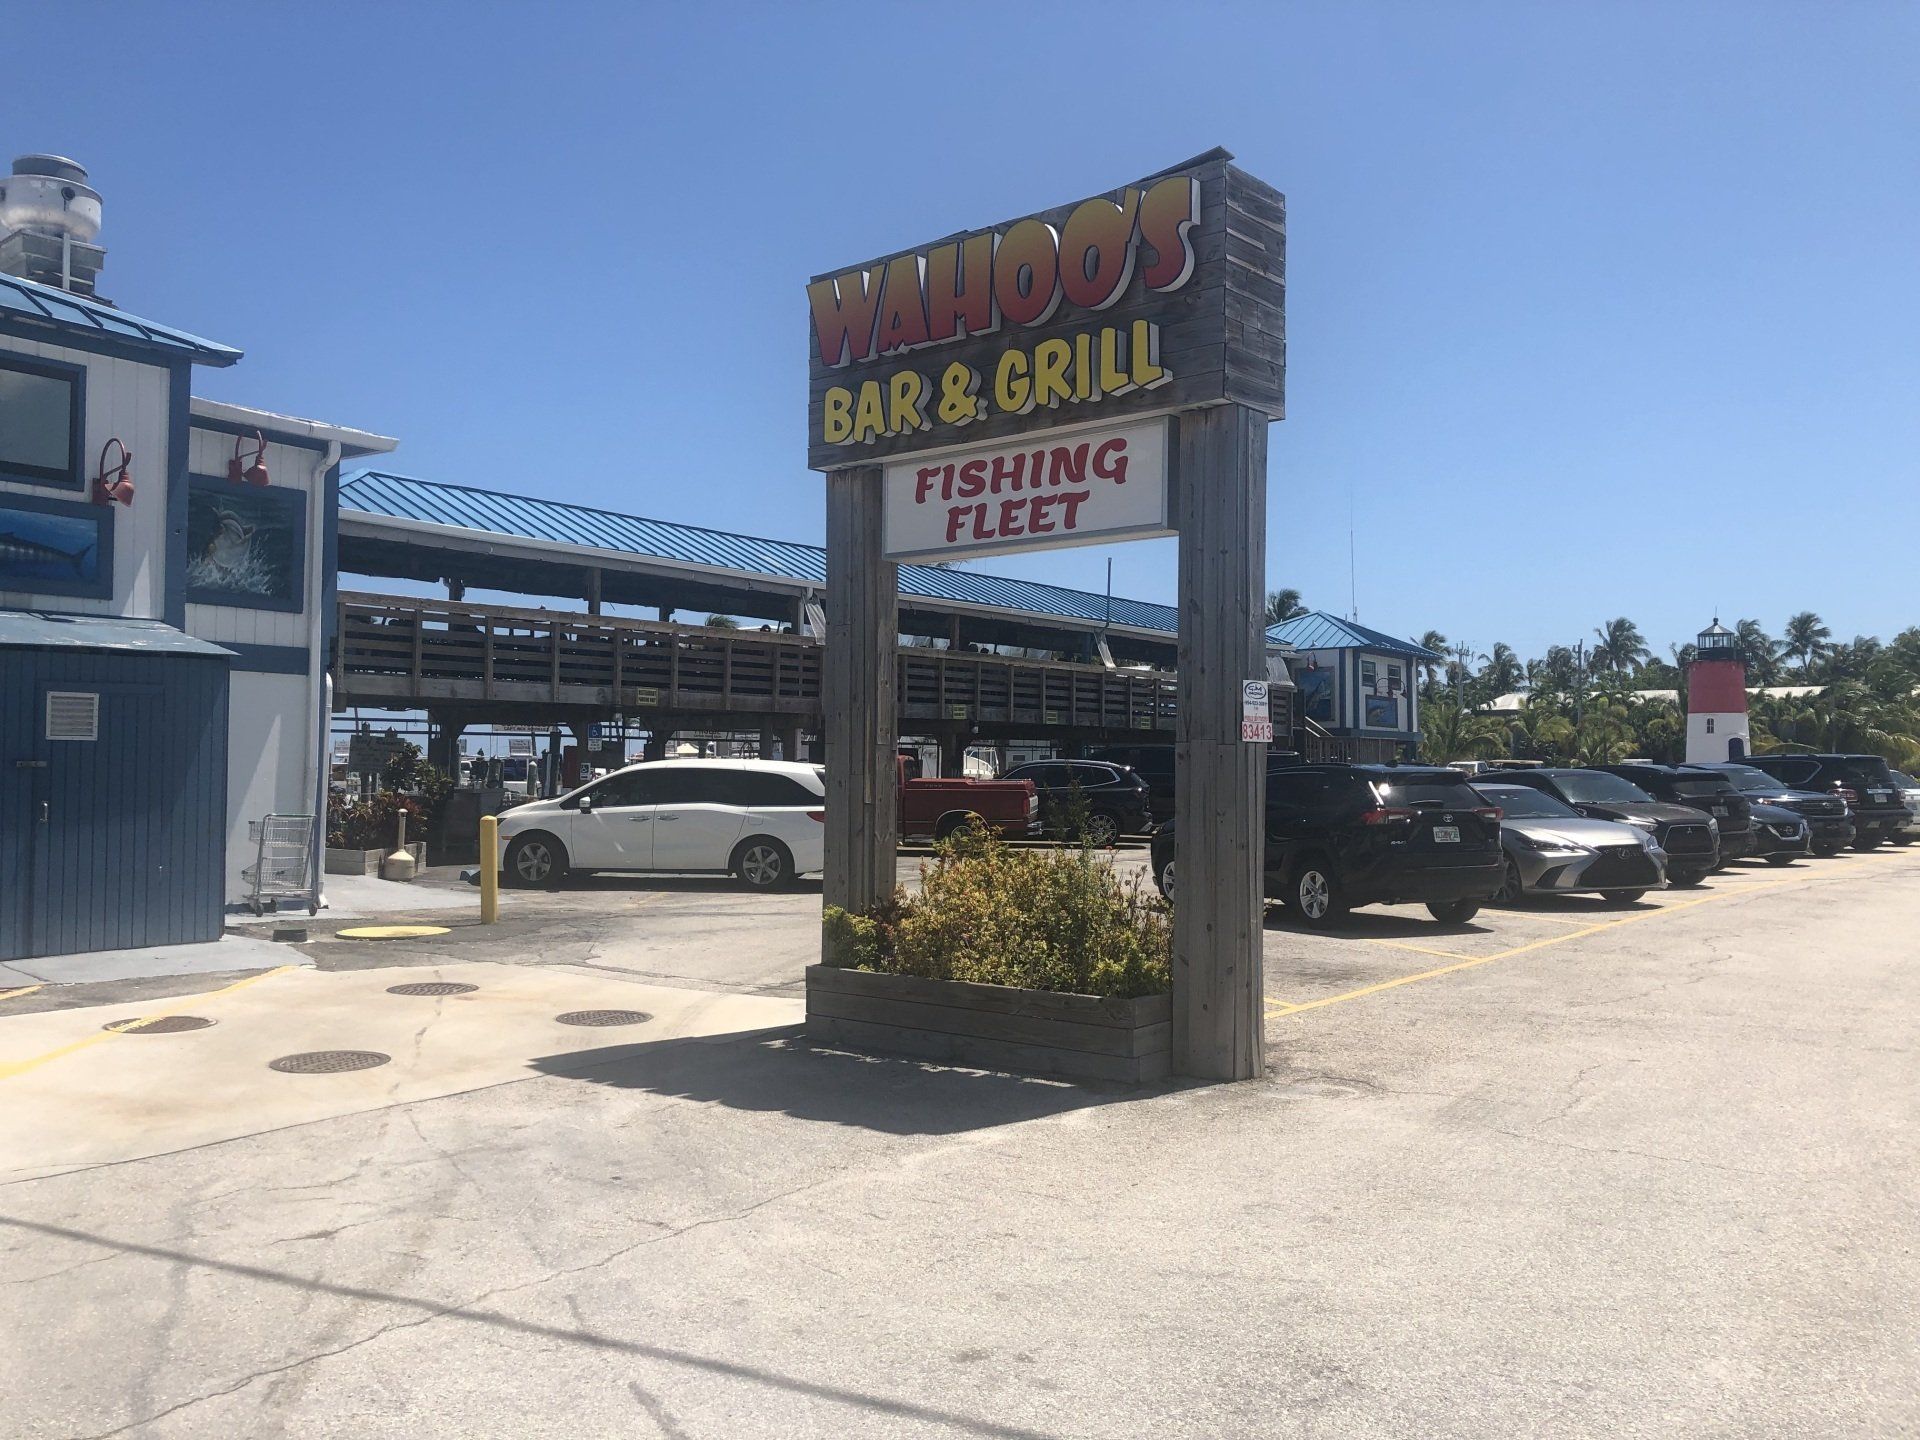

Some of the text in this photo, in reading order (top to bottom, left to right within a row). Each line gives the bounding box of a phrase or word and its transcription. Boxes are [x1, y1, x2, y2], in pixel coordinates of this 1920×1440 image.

[806, 175, 1201, 368] WAHOO'S
[823, 319, 1174, 445] BAR & GRILL
[914, 437, 1129, 504] FISHING
[945, 490, 1091, 542] FLEET
[1242, 723, 1272, 740] 83413
